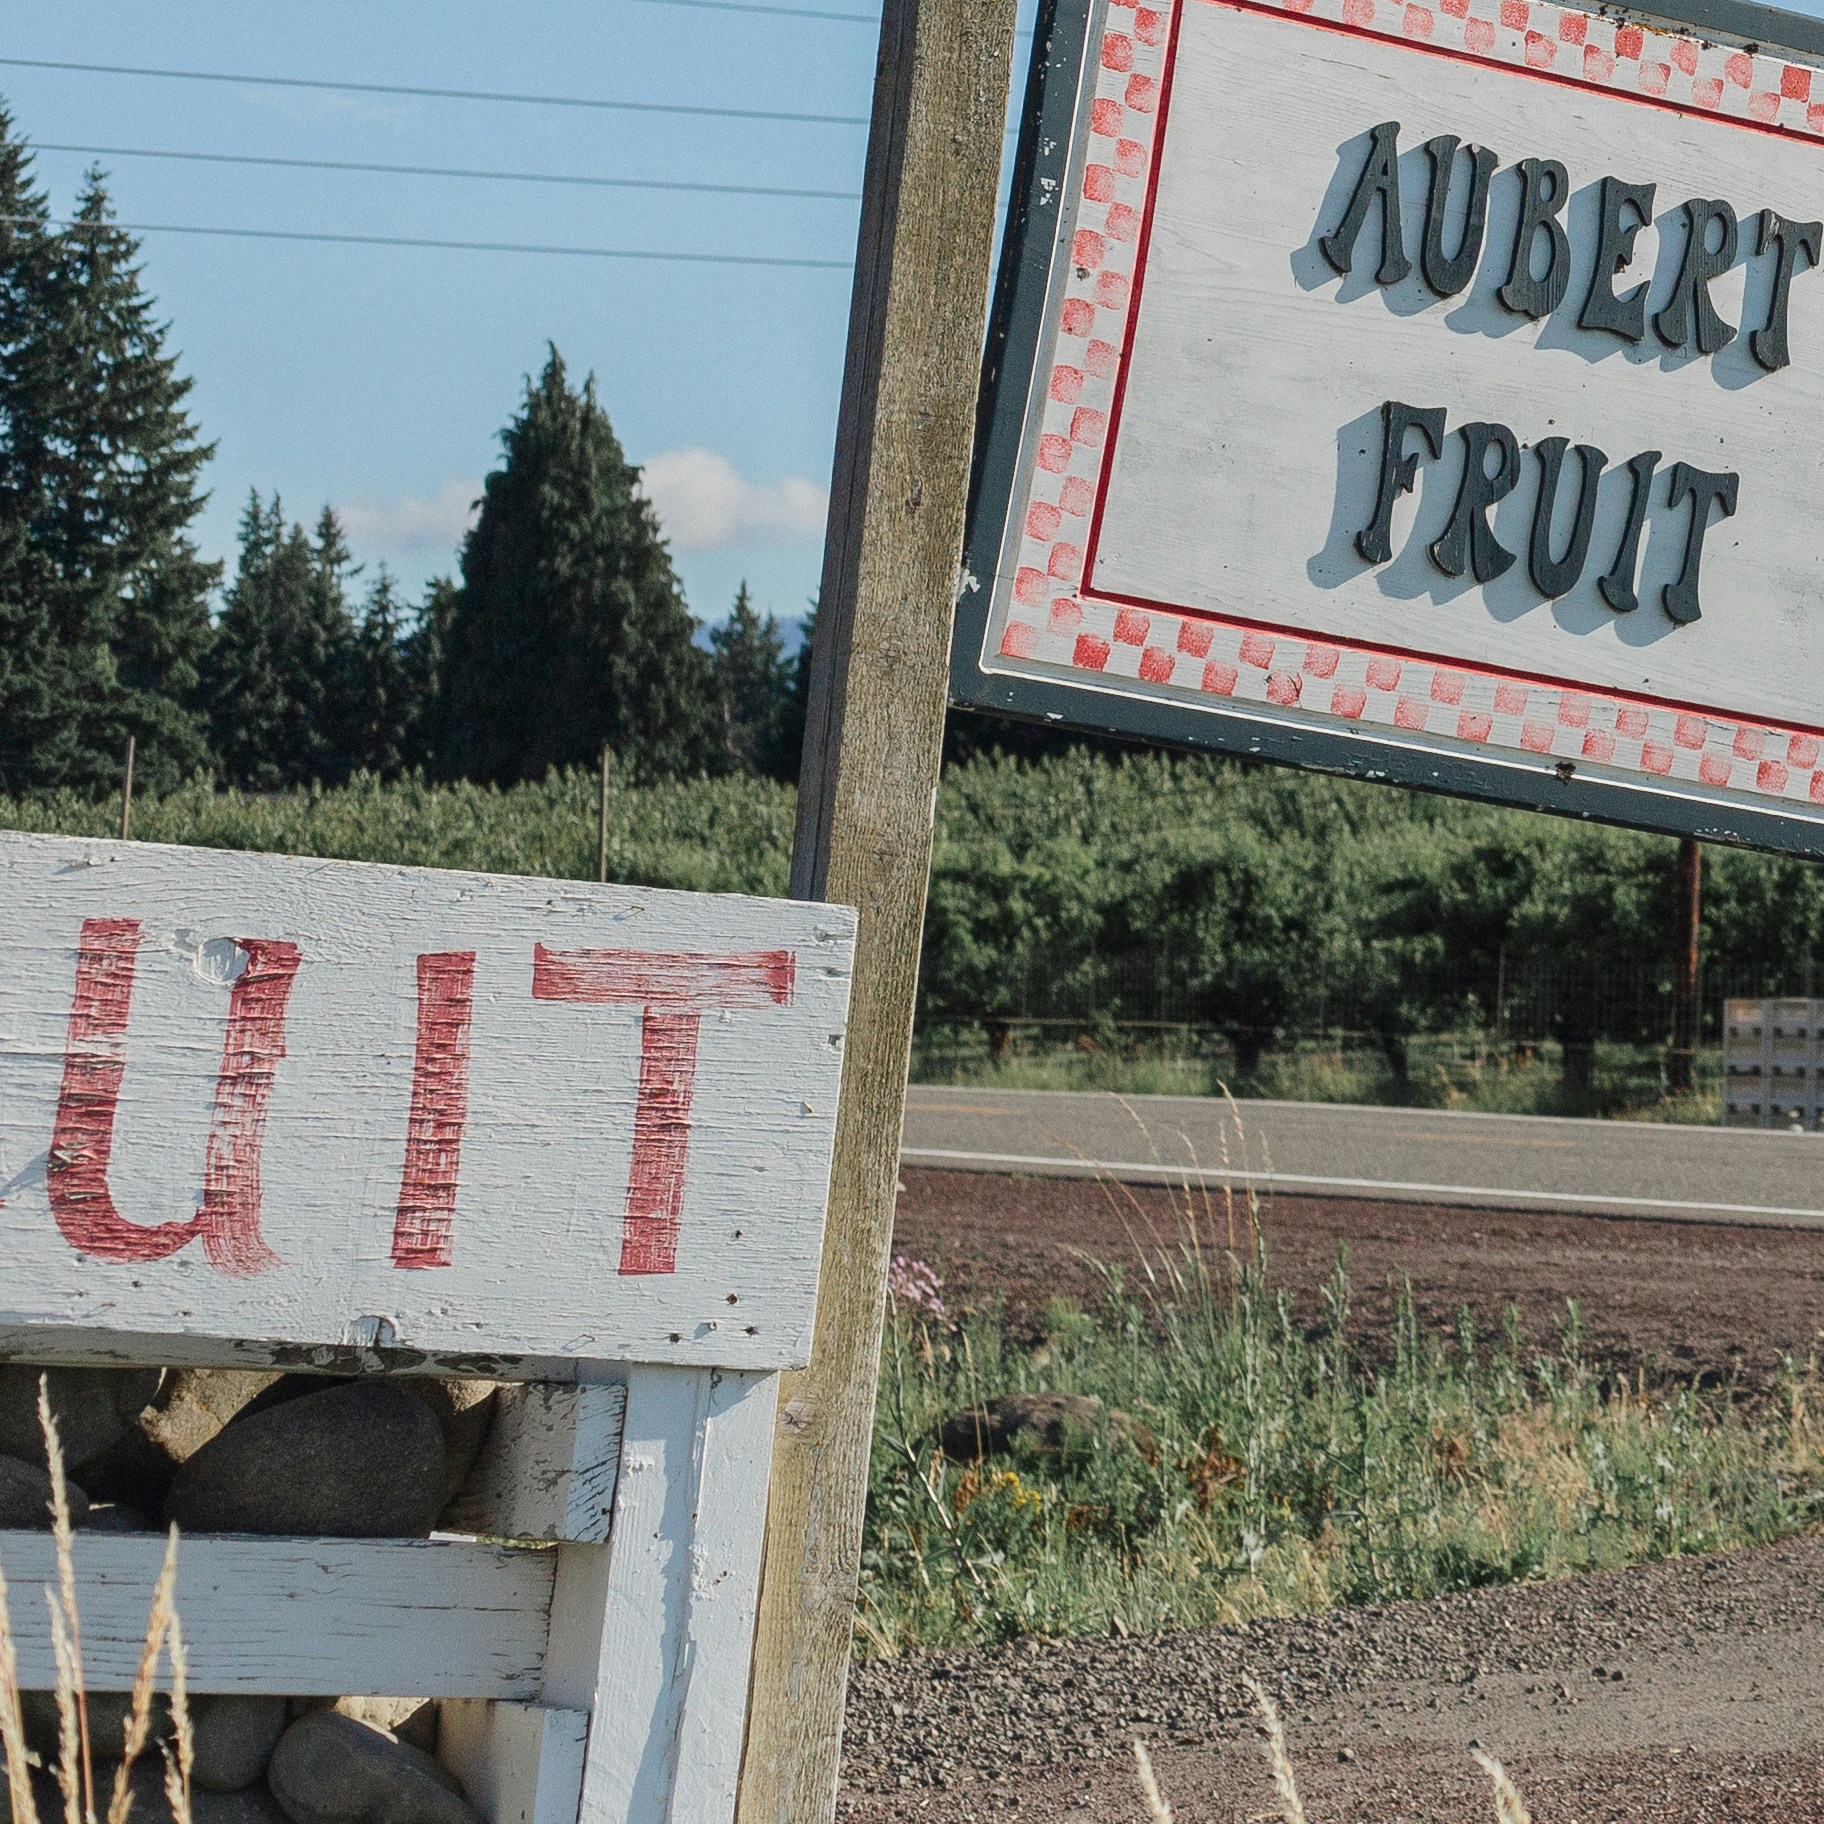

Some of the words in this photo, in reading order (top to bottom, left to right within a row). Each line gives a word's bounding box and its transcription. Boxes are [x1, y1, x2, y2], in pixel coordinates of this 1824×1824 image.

[1318, 120, 1823, 373] AUBERT
[1354, 399, 1740, 625] FRUIT
[0, 917, 798, 1278] UIT
